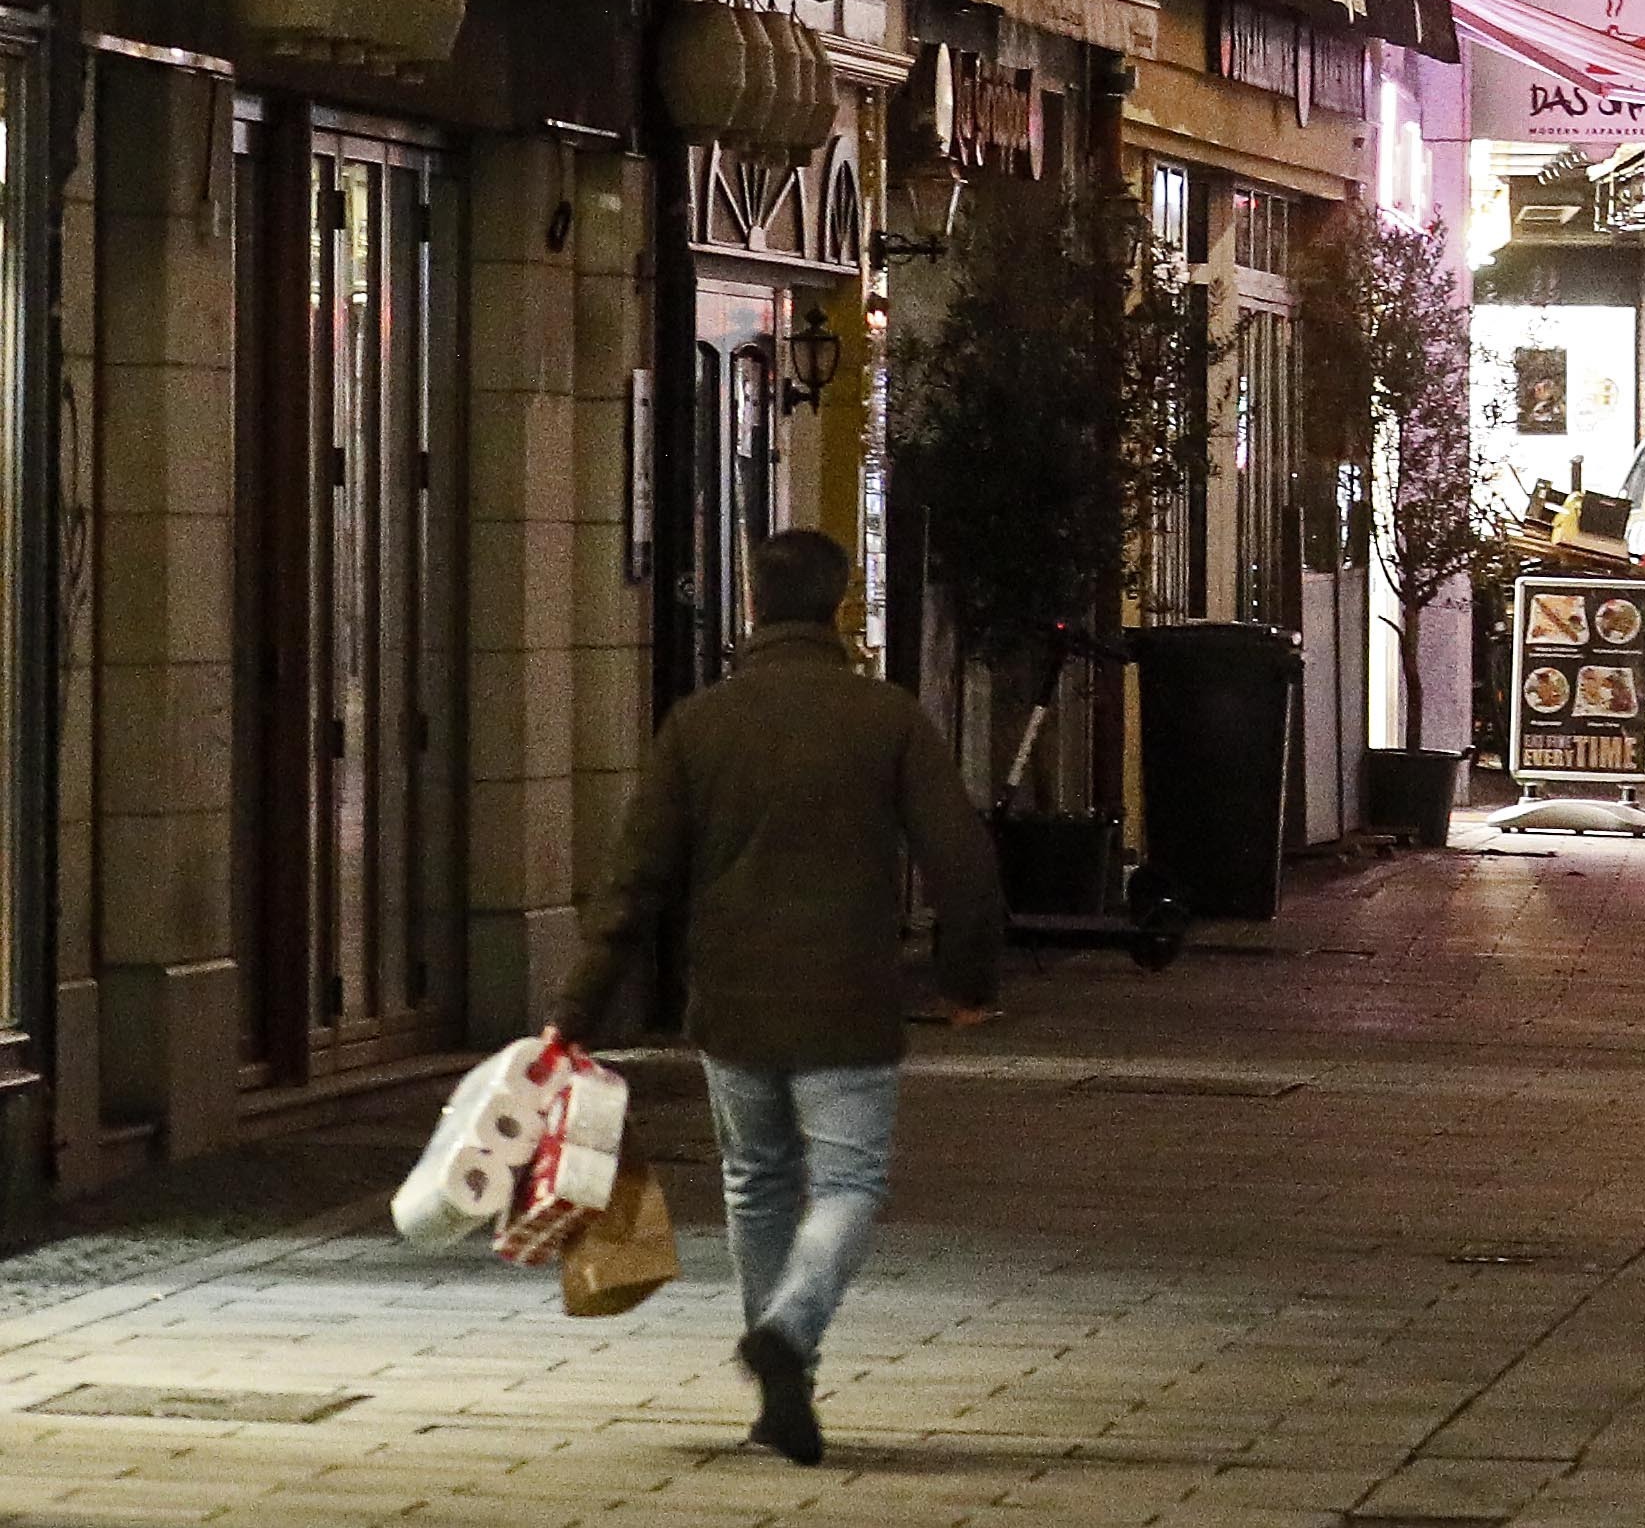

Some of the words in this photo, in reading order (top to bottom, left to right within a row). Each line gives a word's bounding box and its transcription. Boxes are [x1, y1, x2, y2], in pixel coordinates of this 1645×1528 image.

[1529, 83, 1588, 117] DAS
[1529, 127, 1580, 136] MODERN
[1585, 127, 1645, 136] JAPANESE
[1522, 748, 1575, 767] EVERY
[1573, 735, 1638, 770] TIME
